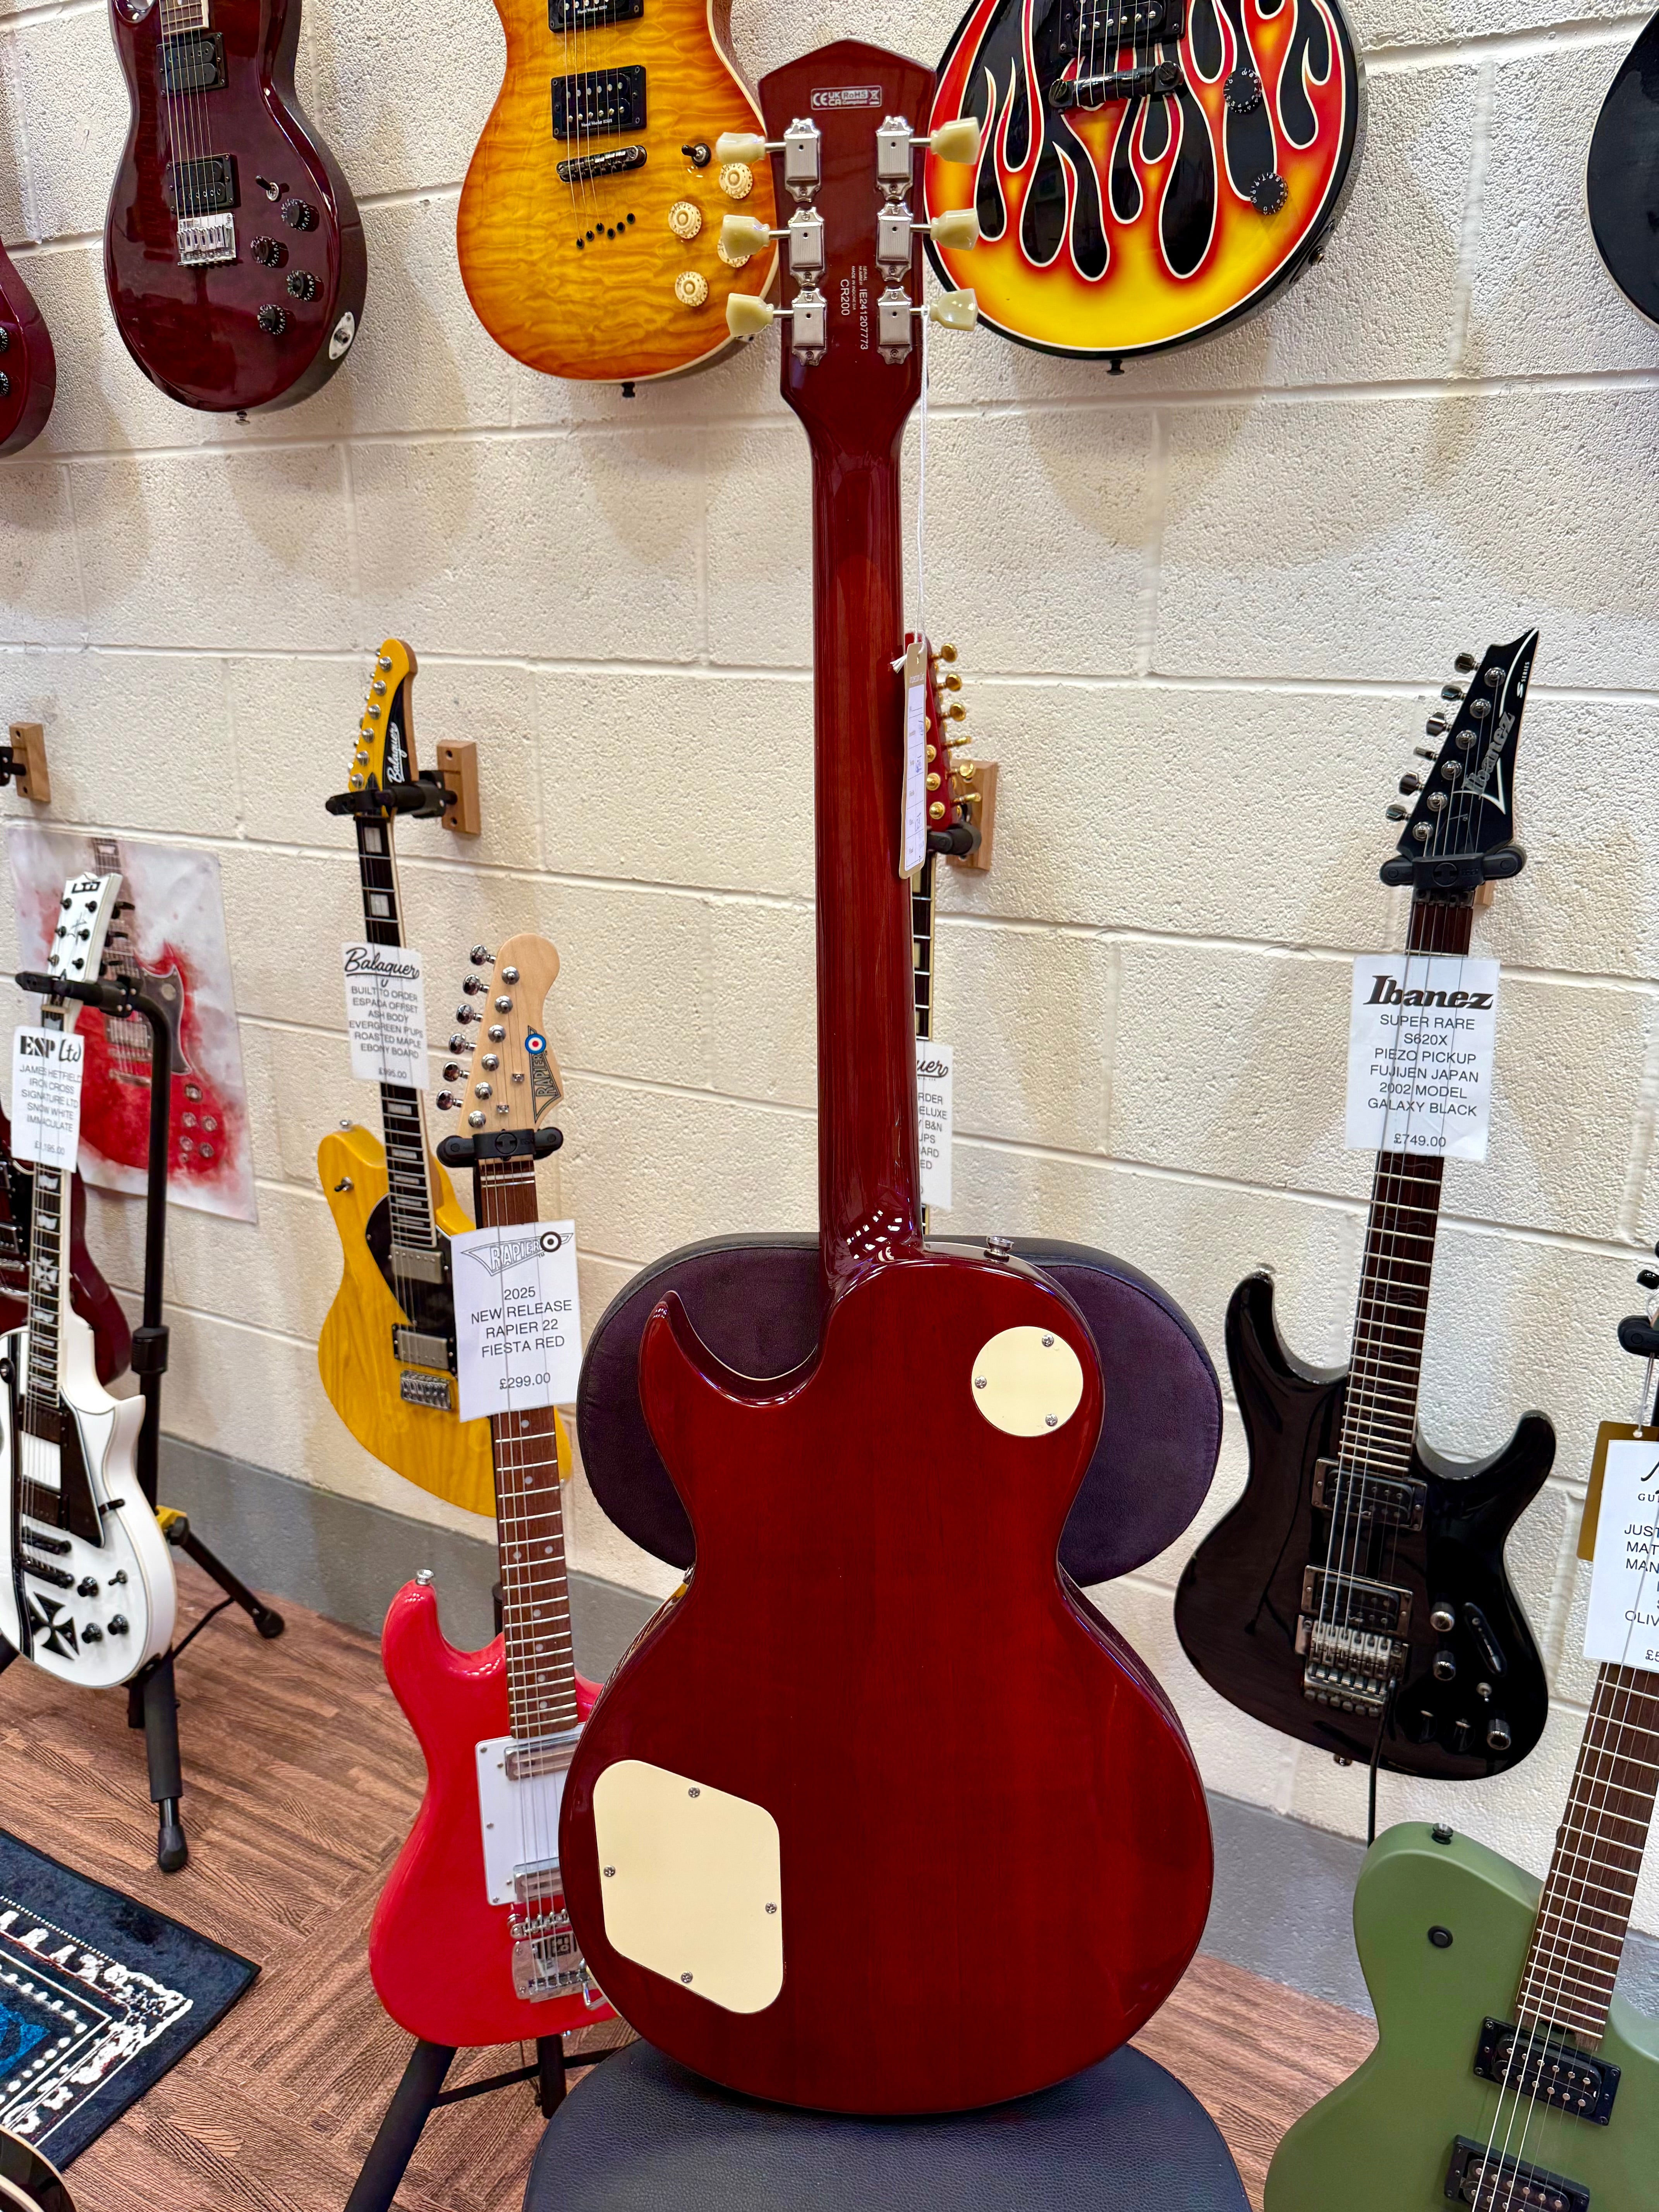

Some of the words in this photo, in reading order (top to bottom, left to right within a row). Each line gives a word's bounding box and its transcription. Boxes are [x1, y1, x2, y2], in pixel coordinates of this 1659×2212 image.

[828, 98, 841, 106] CA
[843, 90, 866, 99] RoHS
[840, 279, 850, 316] CR200
[859, 289, 868, 350] IE241207773
[1521, 661, 1530, 682] SERIES
[1461, 711, 1515, 800] Ibanez
[352, 986, 376, 995] BUILT
[380, 988, 390, 998] TO
[392, 990, 418, 1001] ORDER
[1363, 975, 1494, 1010] Ibanez
[353, 997, 387, 1008] ESPADA
[389, 1001, 418, 1013] OFFSET
[368, 1010, 385, 1019] ASH
[387, 1012, 409, 1023] BODY
[1380, 1014, 1429, 1028] SUPER
[1434, 1017, 1475, 1030] RARE
[349, 1020, 402, 1034] EVERGREEN
[355, 1031, 395, 1044] ROASTED
[397, 1036, 422, 1049] MAPLE
[1403, 1033, 1448, 1046] S620X
[20, 1035, 55, 1058] ESP
[59, 1038, 82, 1062] Ltd
[361, 1043, 389, 1054] EBONY
[392, 1047, 419, 1059] BOARD
[1375, 1048, 1417, 1061] PIEZO
[1422, 1051, 1476, 1065] PICKUP
[19, 1064, 47, 1076] JAMES
[532, 1053, 558, 1097] RAPIER
[1370, 1064, 1427, 1079] FUJIJEN
[1431, 1069, 1479, 1083] JAPAN
[29, 1078, 48, 1089] IRON
[49, 1082, 74, 1094] CROSS
[1379, 1082, 1411, 1095] 2002
[1415, 1085, 1467, 1099] MODEL
[21, 1089, 65, 1105] SIGNATURE
[66, 1098, 79, 1109] LTD
[918, 1092, 943, 1105] RDER
[1368, 1097, 1425, 1112] GALAXY
[1429, 1103, 1477, 1116] BLACK
[27, 1102, 49, 1113] SNOW
[51, 1108, 74, 1120] WHITE
[919, 1106, 947, 1120] ELUXE
[27, 1114, 74, 1132] IMMACULATE
[925, 1120, 942, 1132] B&N
[1394, 1133, 1446, 1147] £749.00
[921, 1147, 939, 1158] ARD
[920, 1159, 933, 1170] ED
[490, 1239, 542, 1271] RAPIER
[504, 1286, 536, 1300] 2025
[471, 1307, 502, 1324] NEW
[507, 1300, 572, 1318] RELEASE
[486, 1321, 538, 1339] RAPIER
[543, 1319, 558, 1331] 22
[482, 1340, 532, 1358] FIESTA
[535, 1336, 565, 1350] RED
[500, 1372, 551, 1390] £299.00
[1638, 1493, 1659, 1503] GU
